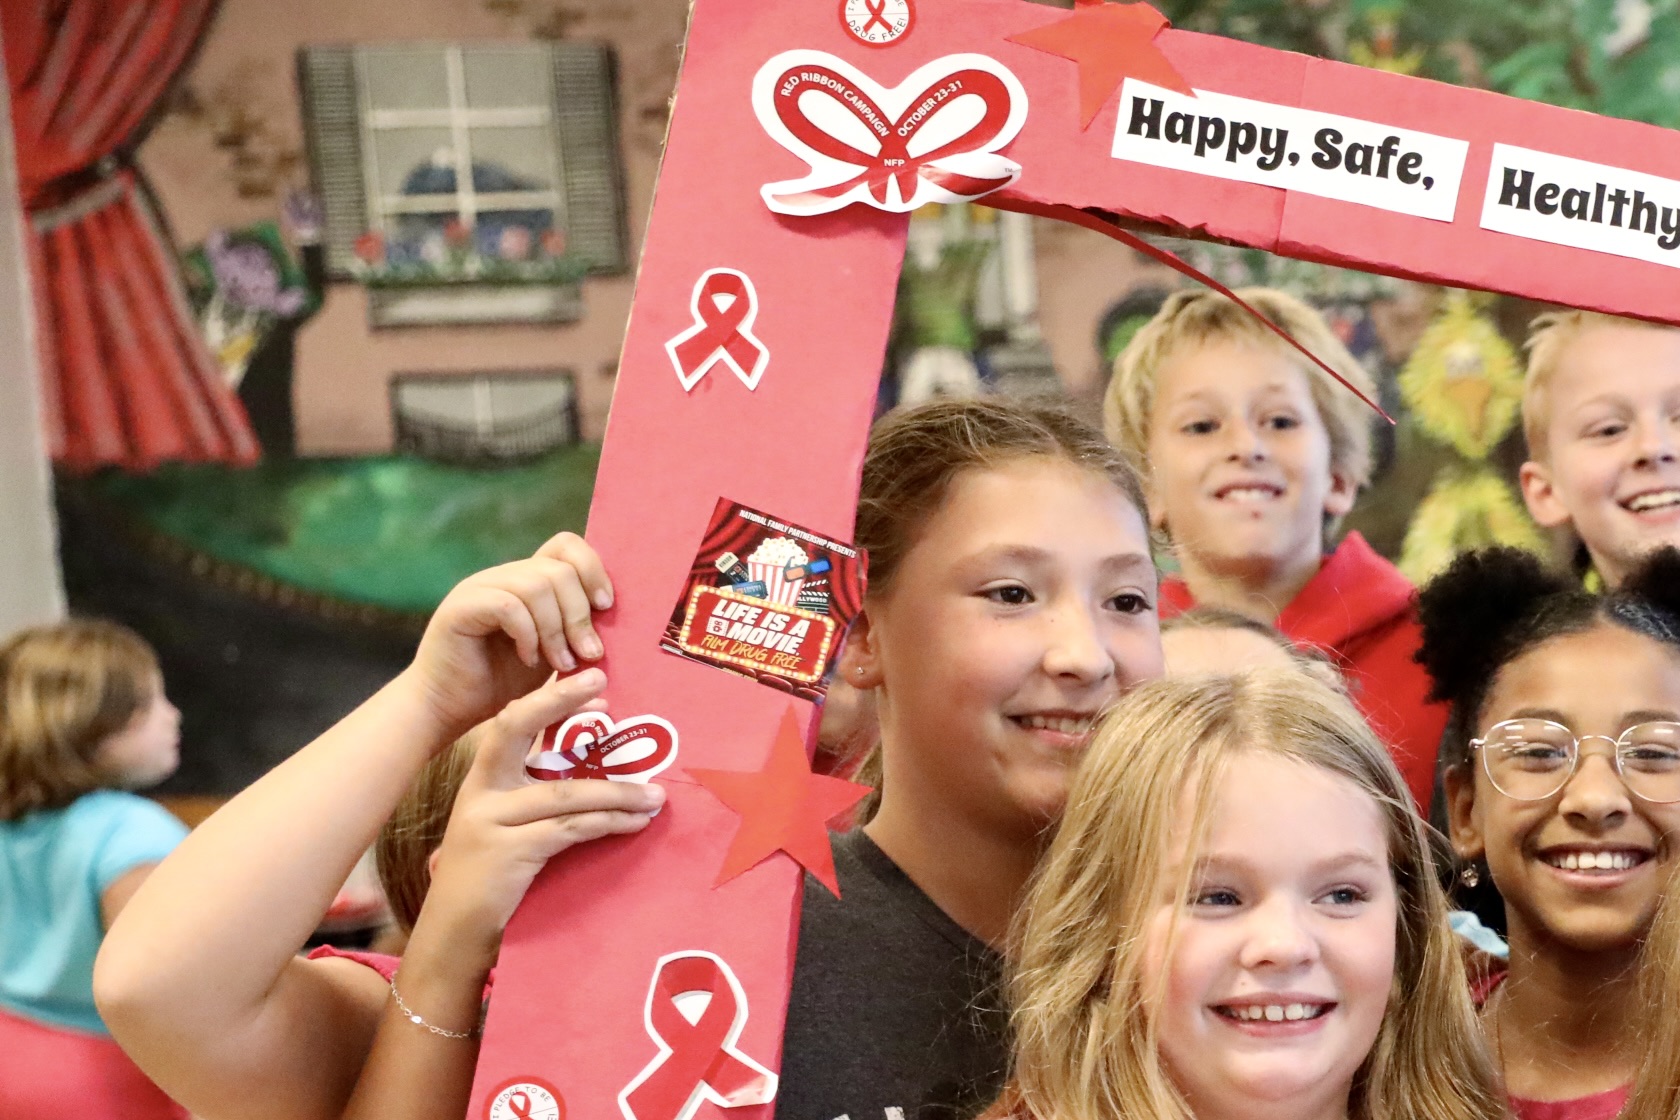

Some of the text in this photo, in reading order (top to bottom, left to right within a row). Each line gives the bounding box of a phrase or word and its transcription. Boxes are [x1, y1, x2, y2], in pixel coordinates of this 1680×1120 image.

[848, 18, 907, 41] DRUG FREE!
[781, 72, 890, 137] RED RIBBON CAMPAIGN
[897, 80, 963, 137] OCTOBER 23-31
[1127, 96, 1300, 171] Happy,
[1311, 128, 1435, 190] Safe,
[883, 158, 905, 167] NFP
[739, 509, 857, 558] NATIONAL FAMILY PARTNERSHIP PRESENTS
[711, 598, 811, 638] LIFE IS A
[700, 635, 728, 651] FILM
[729, 640, 769, 662] DRUG
[770, 652, 802, 669] FREE
[727, 622, 804, 656] MOVIE.
[600, 734, 629, 753] OCTOBER
[525, 1086, 537, 1094] TO
